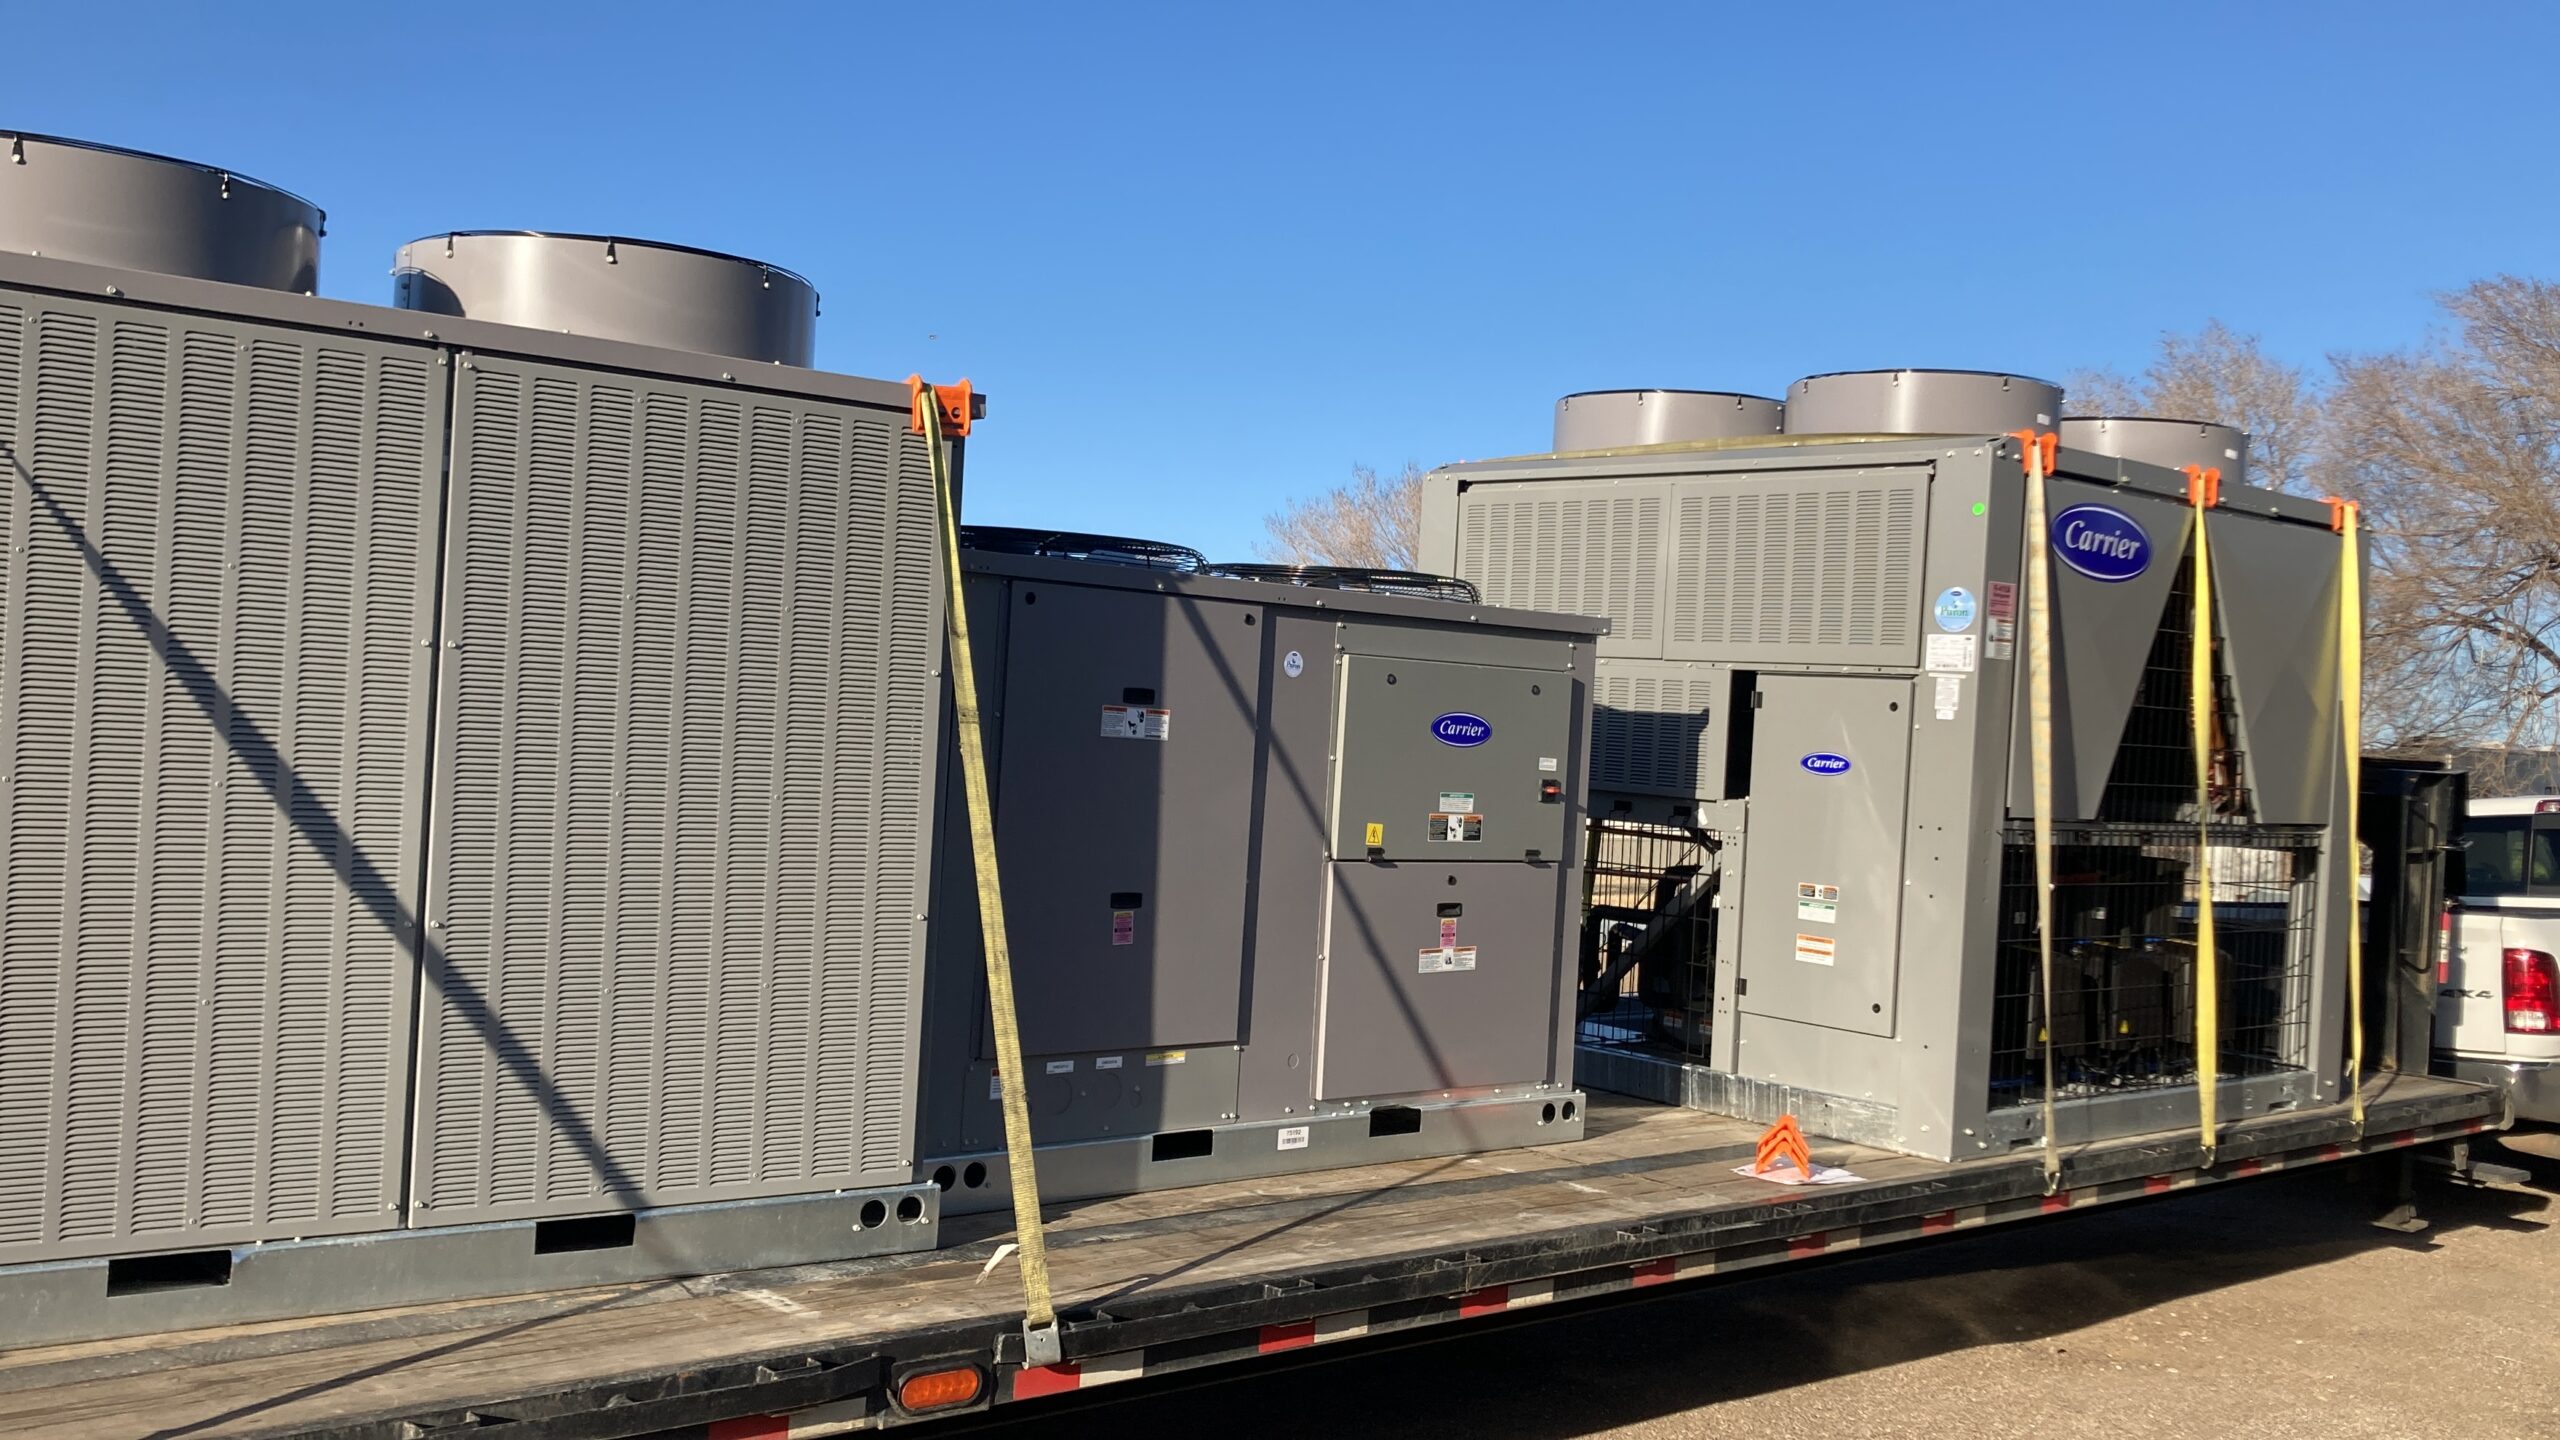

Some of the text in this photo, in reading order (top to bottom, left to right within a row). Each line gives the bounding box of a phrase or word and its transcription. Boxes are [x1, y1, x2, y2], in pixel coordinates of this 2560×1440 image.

[2065, 520, 2141, 560] Carrier
[1940, 605, 1968, 617] Puron
[1440, 720, 1484, 737] Carrier
[1807, 757, 1846, 769] Carrier
